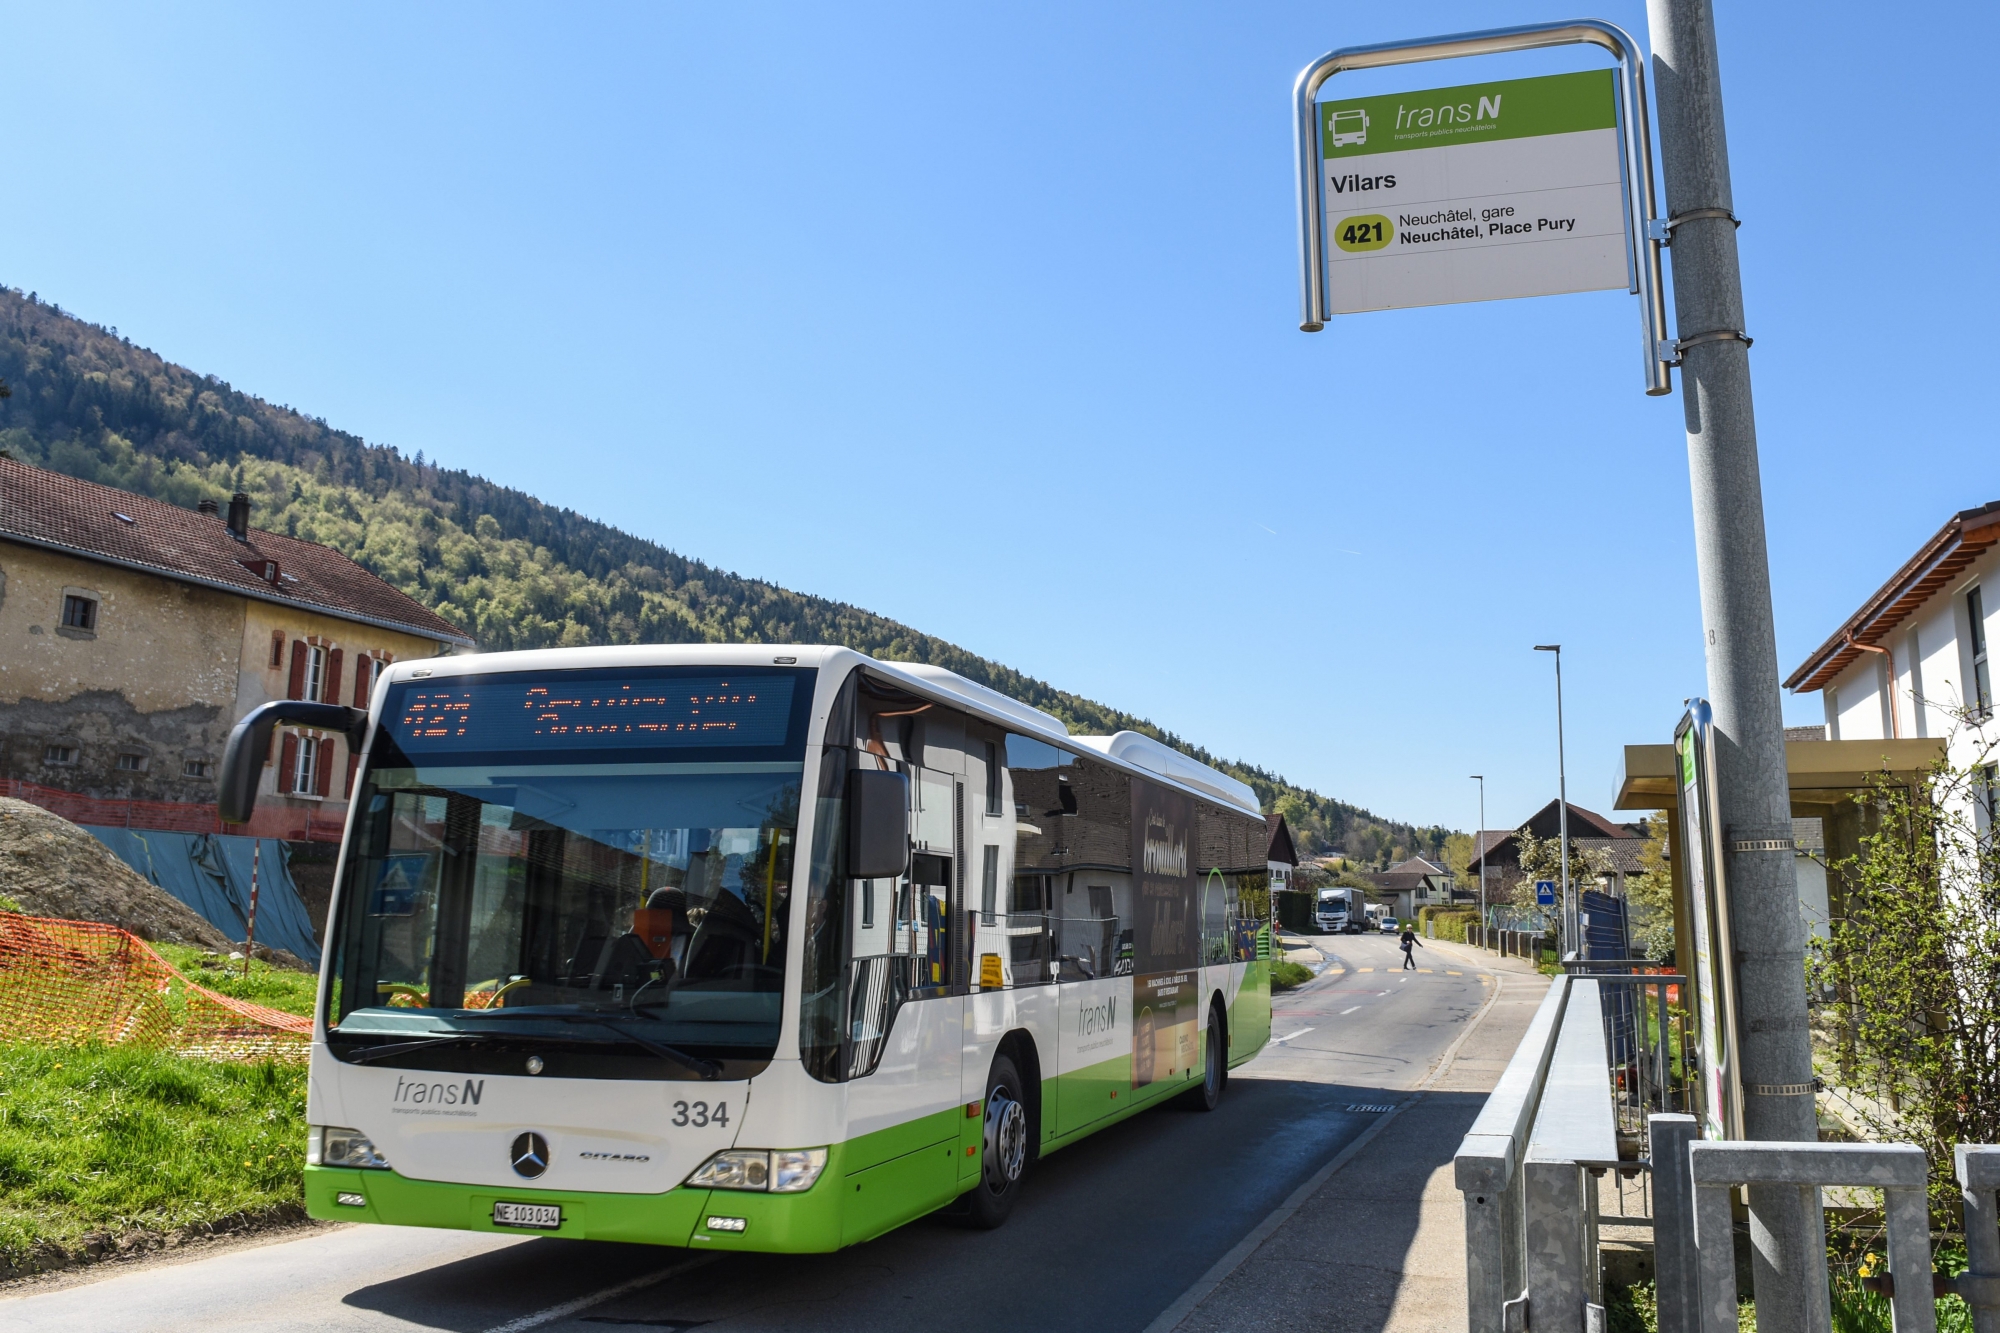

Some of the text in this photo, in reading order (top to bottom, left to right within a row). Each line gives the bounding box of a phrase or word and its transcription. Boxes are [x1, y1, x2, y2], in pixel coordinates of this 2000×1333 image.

[1395, 94, 1502, 130] transN
[1394, 122, 1497, 140] transports publics neuchâtelois
[1331, 173, 1397, 194] Vilars
[1399, 204, 1515, 228] Neuchâtel, gare
[1343, 221, 1384, 245] 421
[1400, 216, 1576, 246] Neuchâtel, Place Pury
[1077, 995, 1117, 1038] transN
[393, 1075, 485, 1105] transN
[671, 1100, 730, 1128] 334
[579, 1151, 650, 1164] CITARO
